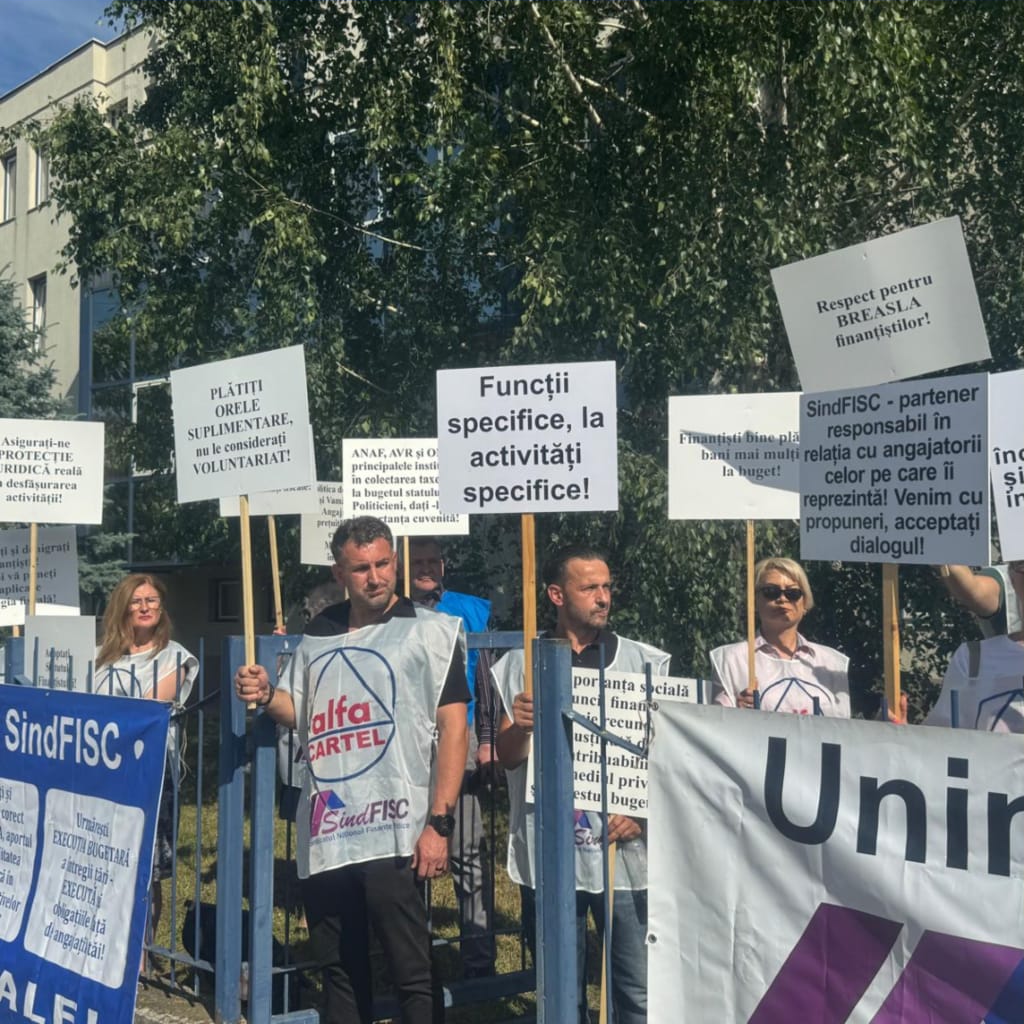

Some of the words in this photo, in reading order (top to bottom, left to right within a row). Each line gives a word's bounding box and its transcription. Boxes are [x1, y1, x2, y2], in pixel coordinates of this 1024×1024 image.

[817, 290, 875, 313] Respect
[880, 276, 932, 301] pentru
[837, 297, 921, 327] BREASLA
[836, 312, 930, 347] finanțiștilor!
[211, 380, 262, 400] PLĂTIȚI
[481, 372, 568, 401] Funcții
[216, 399, 260, 417] ORELE
[806, 394, 880, 417] SindFISC
[900, 387, 979, 413] partener
[188, 413, 292, 440] SUPLIMENTARE,
[448, 408, 571, 438] specifice,
[583, 406, 604, 428] la
[828, 413, 926, 440] responsabil
[933, 412, 950, 430] în
[196, 448, 209, 457] nu
[212, 443, 221, 454] le
[224, 432, 286, 452] considerați
[470, 442, 581, 471] activități
[804, 444, 850, 466] relația
[857, 446, 876, 459] cu
[883, 434, 981, 461] angajatorii
[194, 450, 290, 474] VOLUNTARIAT!
[825, 466, 865, 484] celor
[871, 469, 891, 486] pe
[898, 466, 936, 482] care
[944, 461, 954, 480] îi
[464, 478, 588, 507] specifice!
[804, 489, 887, 510] reprezintă!
[894, 488, 951, 506] Venim
[959, 491, 983, 505] cu
[806, 512, 888, 533] propuneri,
[894, 512, 980, 536] acceptați
[850, 536, 924, 559] dialogul!
[312, 695, 371, 735] alfa
[5, 708, 121, 769] SindFISC
[308, 729, 386, 763] CARTEL
[322, 799, 409, 834] SindFISC
